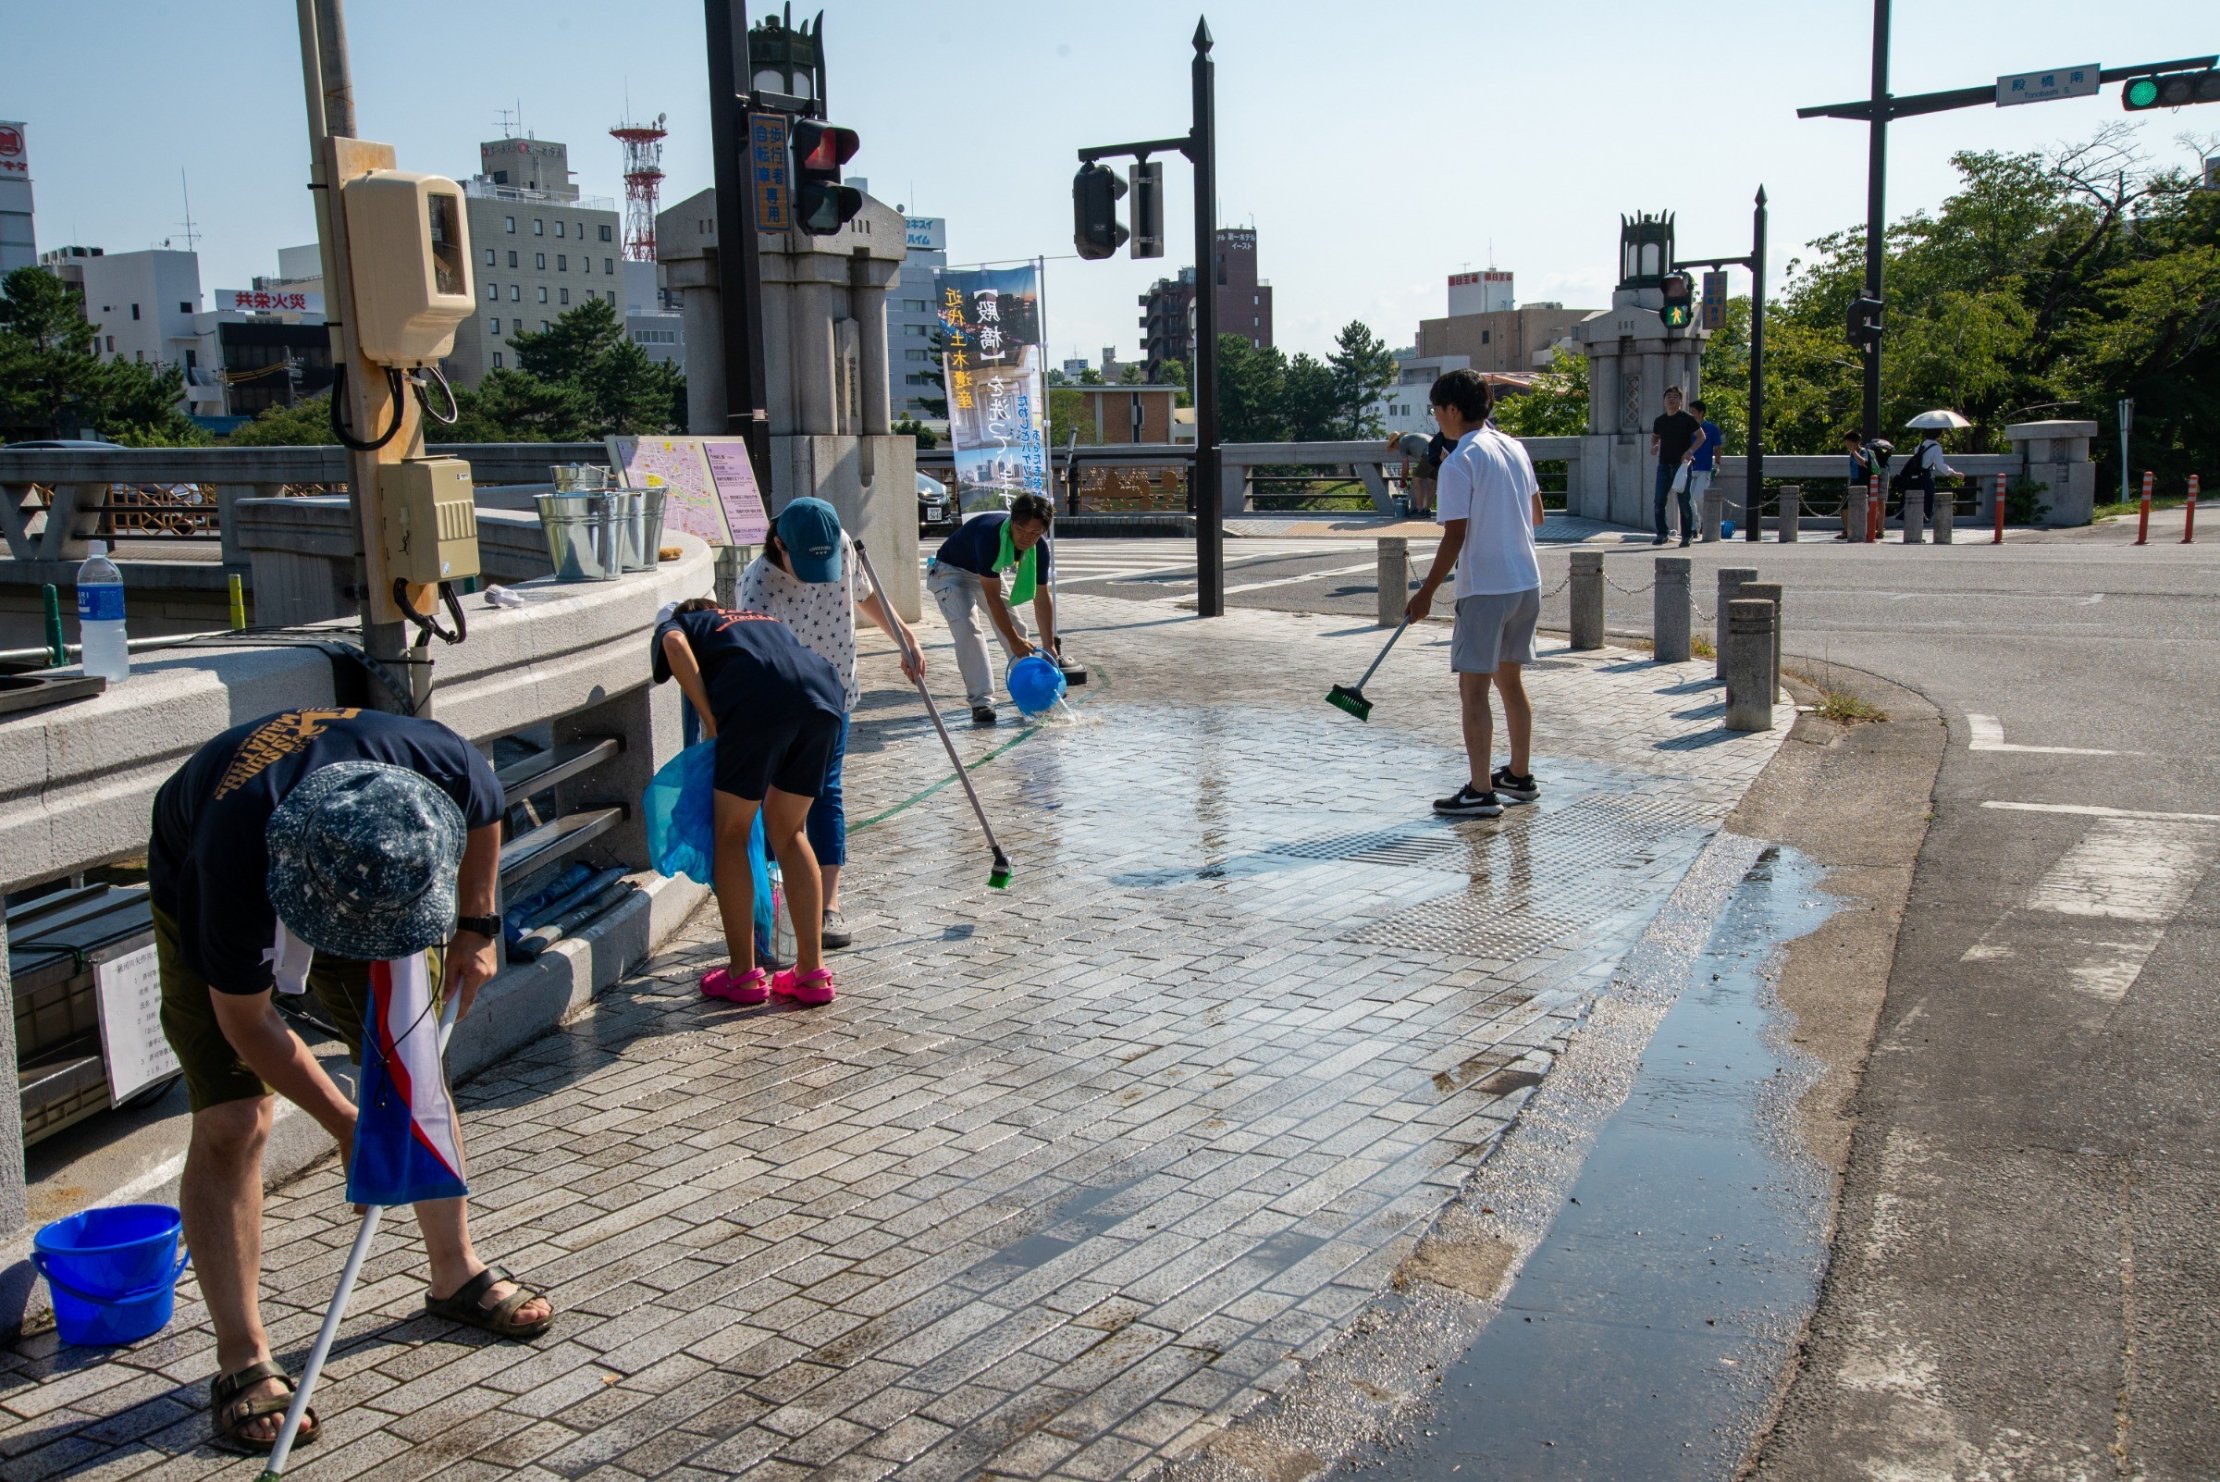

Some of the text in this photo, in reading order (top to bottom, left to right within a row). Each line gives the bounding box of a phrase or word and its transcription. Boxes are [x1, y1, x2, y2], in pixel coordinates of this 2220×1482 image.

[2012, 71, 2084, 92] 殿橋南
[756, 125, 770, 183] 自転車
[766, 187, 780, 223] 専用
[1231, 242, 1252, 250] イースト
[235, 291, 306, 310] 共栄火災
